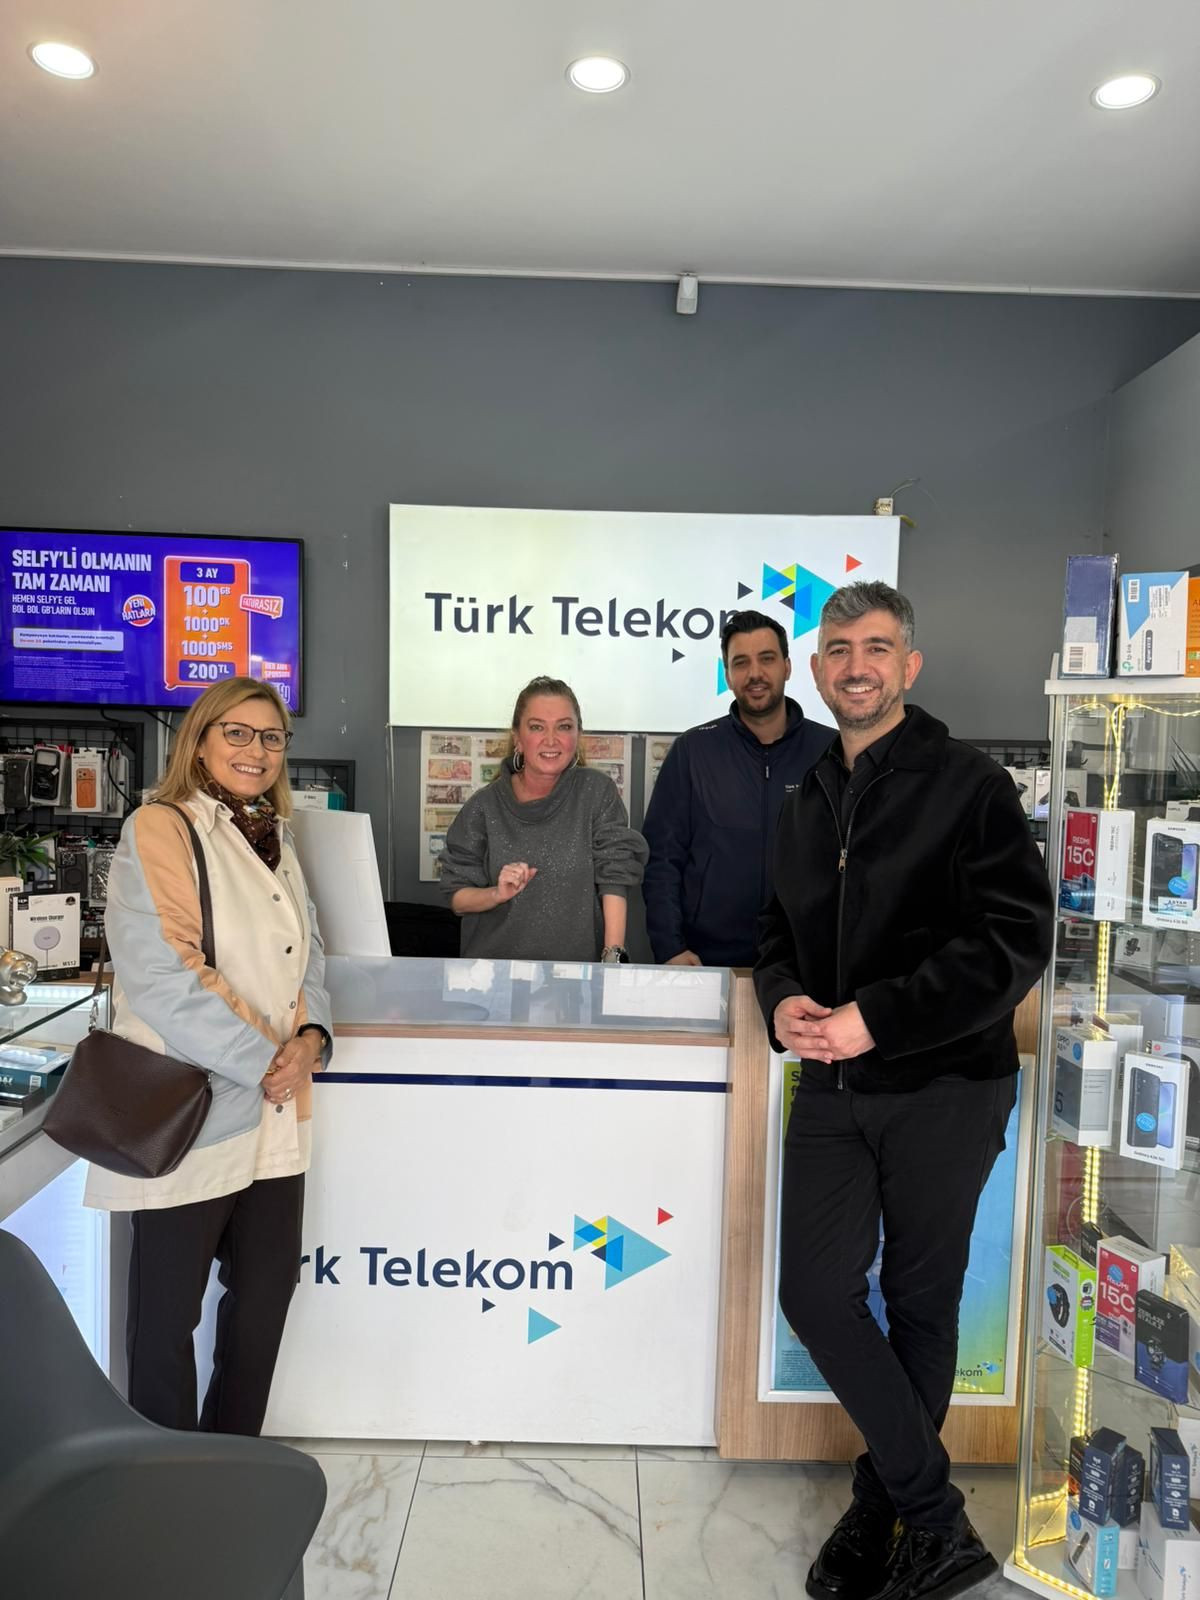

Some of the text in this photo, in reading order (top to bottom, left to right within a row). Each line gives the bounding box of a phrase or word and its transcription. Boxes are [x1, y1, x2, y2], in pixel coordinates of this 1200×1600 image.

[12, 547, 152, 572] SELFY'Lİ OLMANIN
[12, 572, 110, 593] TAM ZAMANI
[196, 567, 218, 578] 3 AY
[12, 594, 35, 604] HEMEN
[64, 596, 76, 605] GEL
[12, 604, 25, 614] BOL
[27, 605, 39, 614] BOL
[73, 607, 95, 616] OLSUN
[243, 597, 280, 614] FATURASIZ
[122, 607, 156, 621] HATLARA
[425, 592, 534, 635] Türk
[1067, 845, 1095, 866] 15C
[359, 1247, 574, 1291] Telekom
[1099, 1281, 1136, 1313] 15C
